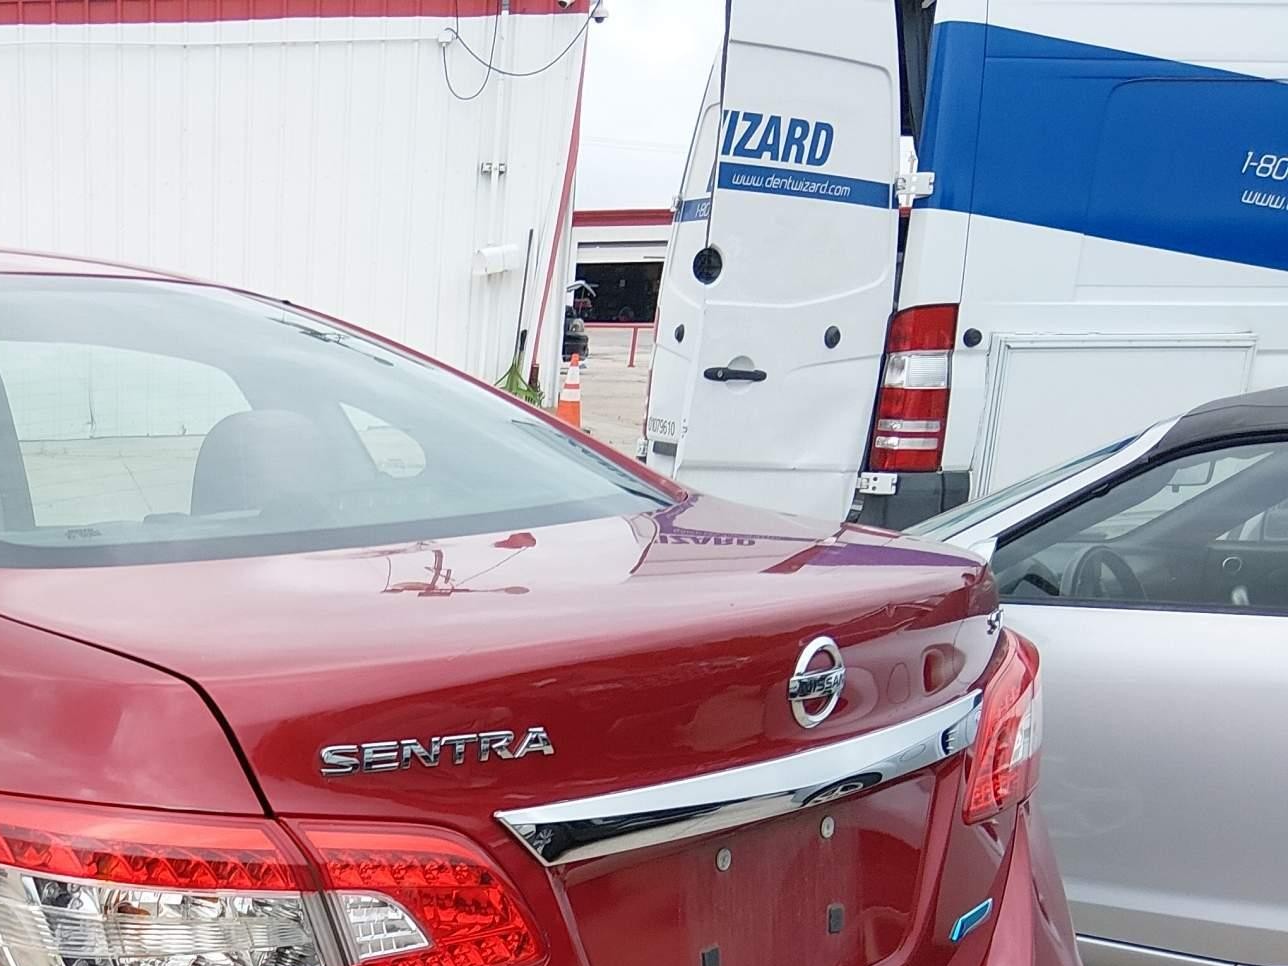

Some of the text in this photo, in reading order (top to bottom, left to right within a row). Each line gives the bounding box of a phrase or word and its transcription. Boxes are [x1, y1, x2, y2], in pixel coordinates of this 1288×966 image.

[731, 172, 851, 198] www.dentwizard.com
[1241, 190, 1288, 211] www.
[320, 727, 555, 777] SENTRA
